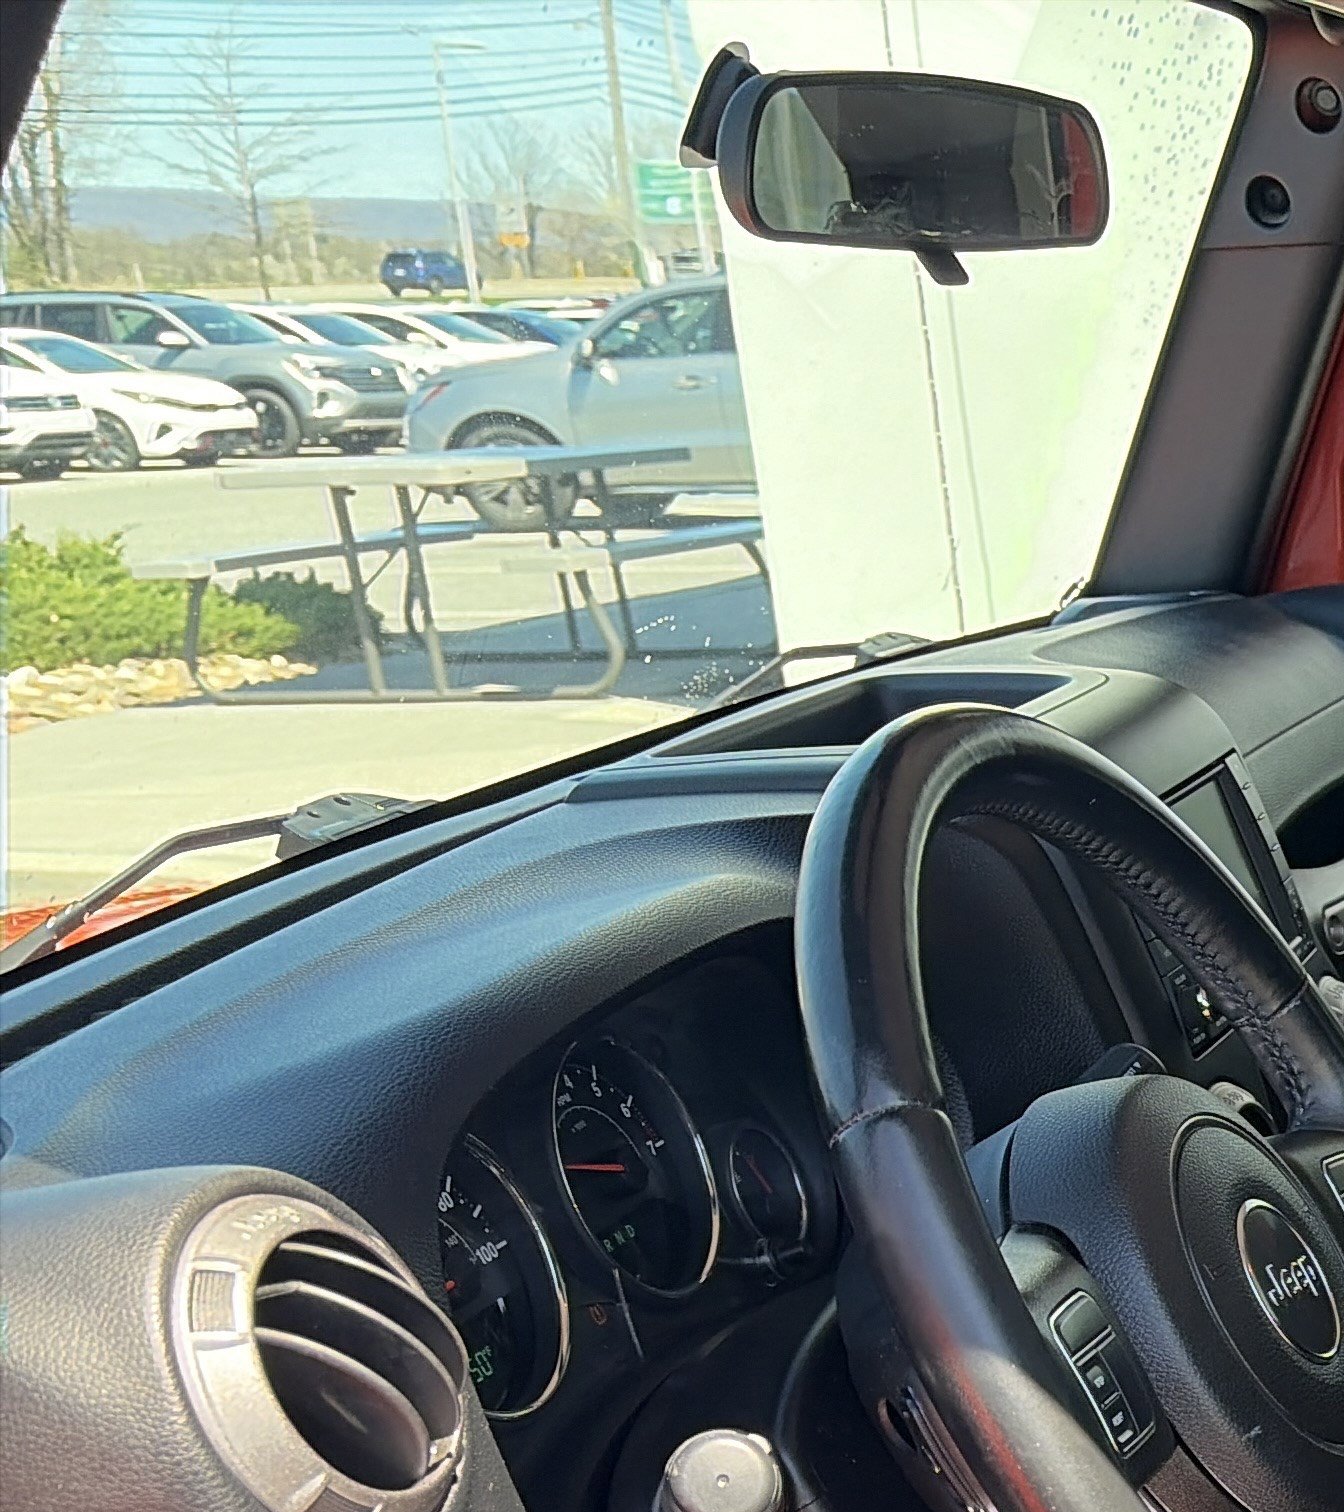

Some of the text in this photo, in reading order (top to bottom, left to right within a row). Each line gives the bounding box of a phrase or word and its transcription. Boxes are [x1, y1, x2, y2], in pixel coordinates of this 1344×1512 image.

[591, 1081, 602, 1097] 5
[620, 1102, 632, 1118] 6
[646, 1140, 656, 1156] 7
[603, 1239, 614, 1252] R
[624, 1224, 635, 1238] D
[475, 1241, 499, 1265] 100
[1265, 1255, 1319, 1307] Jeep
